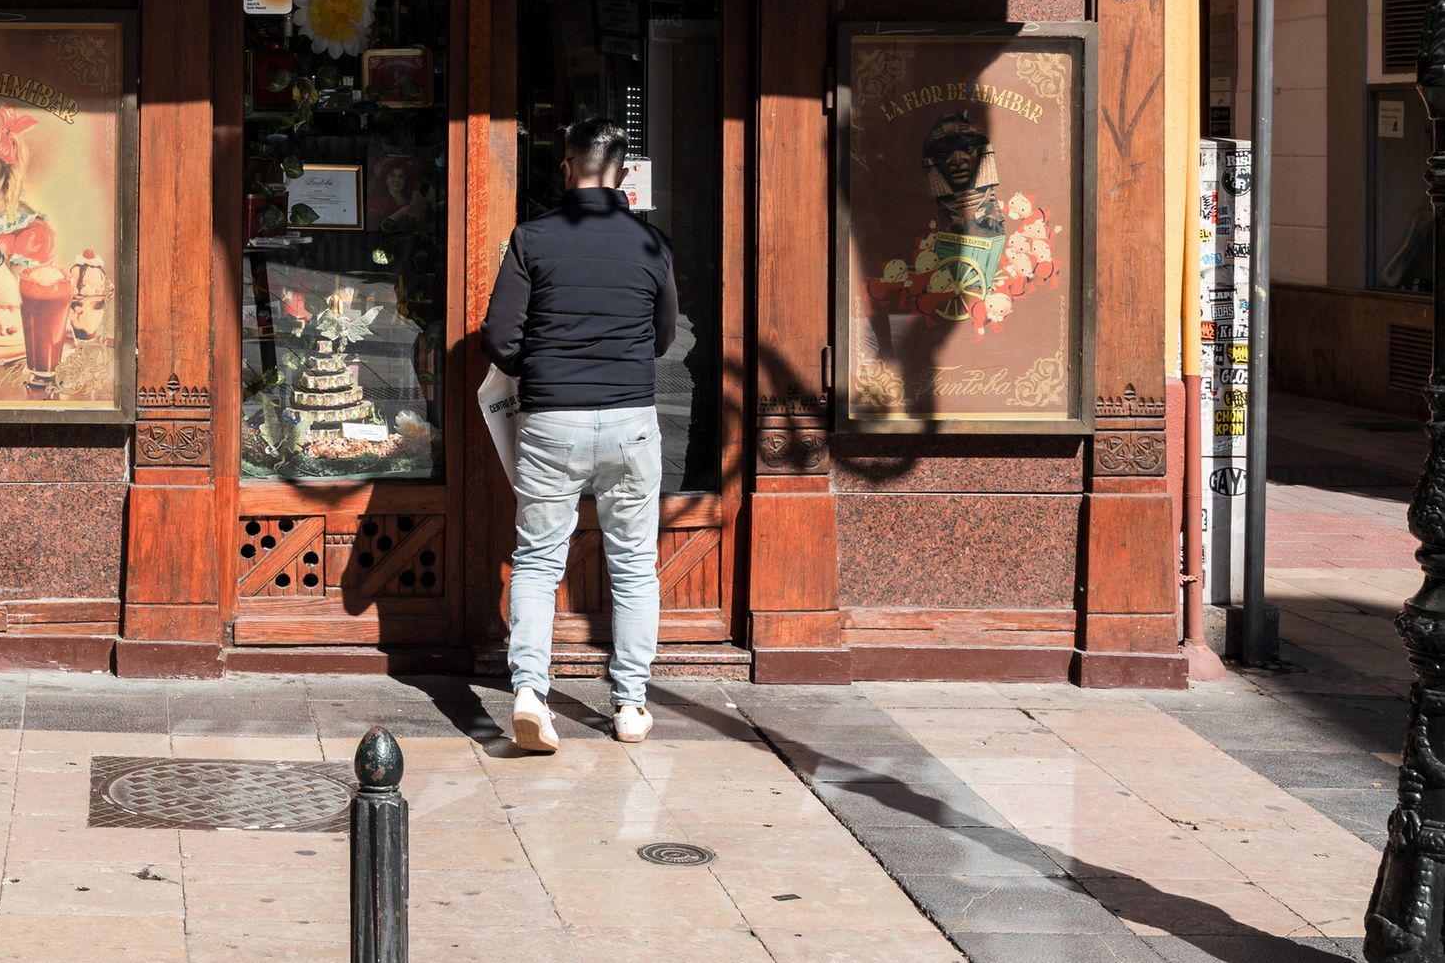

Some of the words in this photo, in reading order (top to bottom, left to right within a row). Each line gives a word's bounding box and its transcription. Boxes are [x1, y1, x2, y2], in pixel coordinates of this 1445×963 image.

[879, 100, 905, 122] LA
[902, 85, 944, 111] FLOR
[946, 83, 967, 101] DE
[970, 83, 1044, 124] ALMIBAR
[909, 364, 1011, 400] Fantoba
